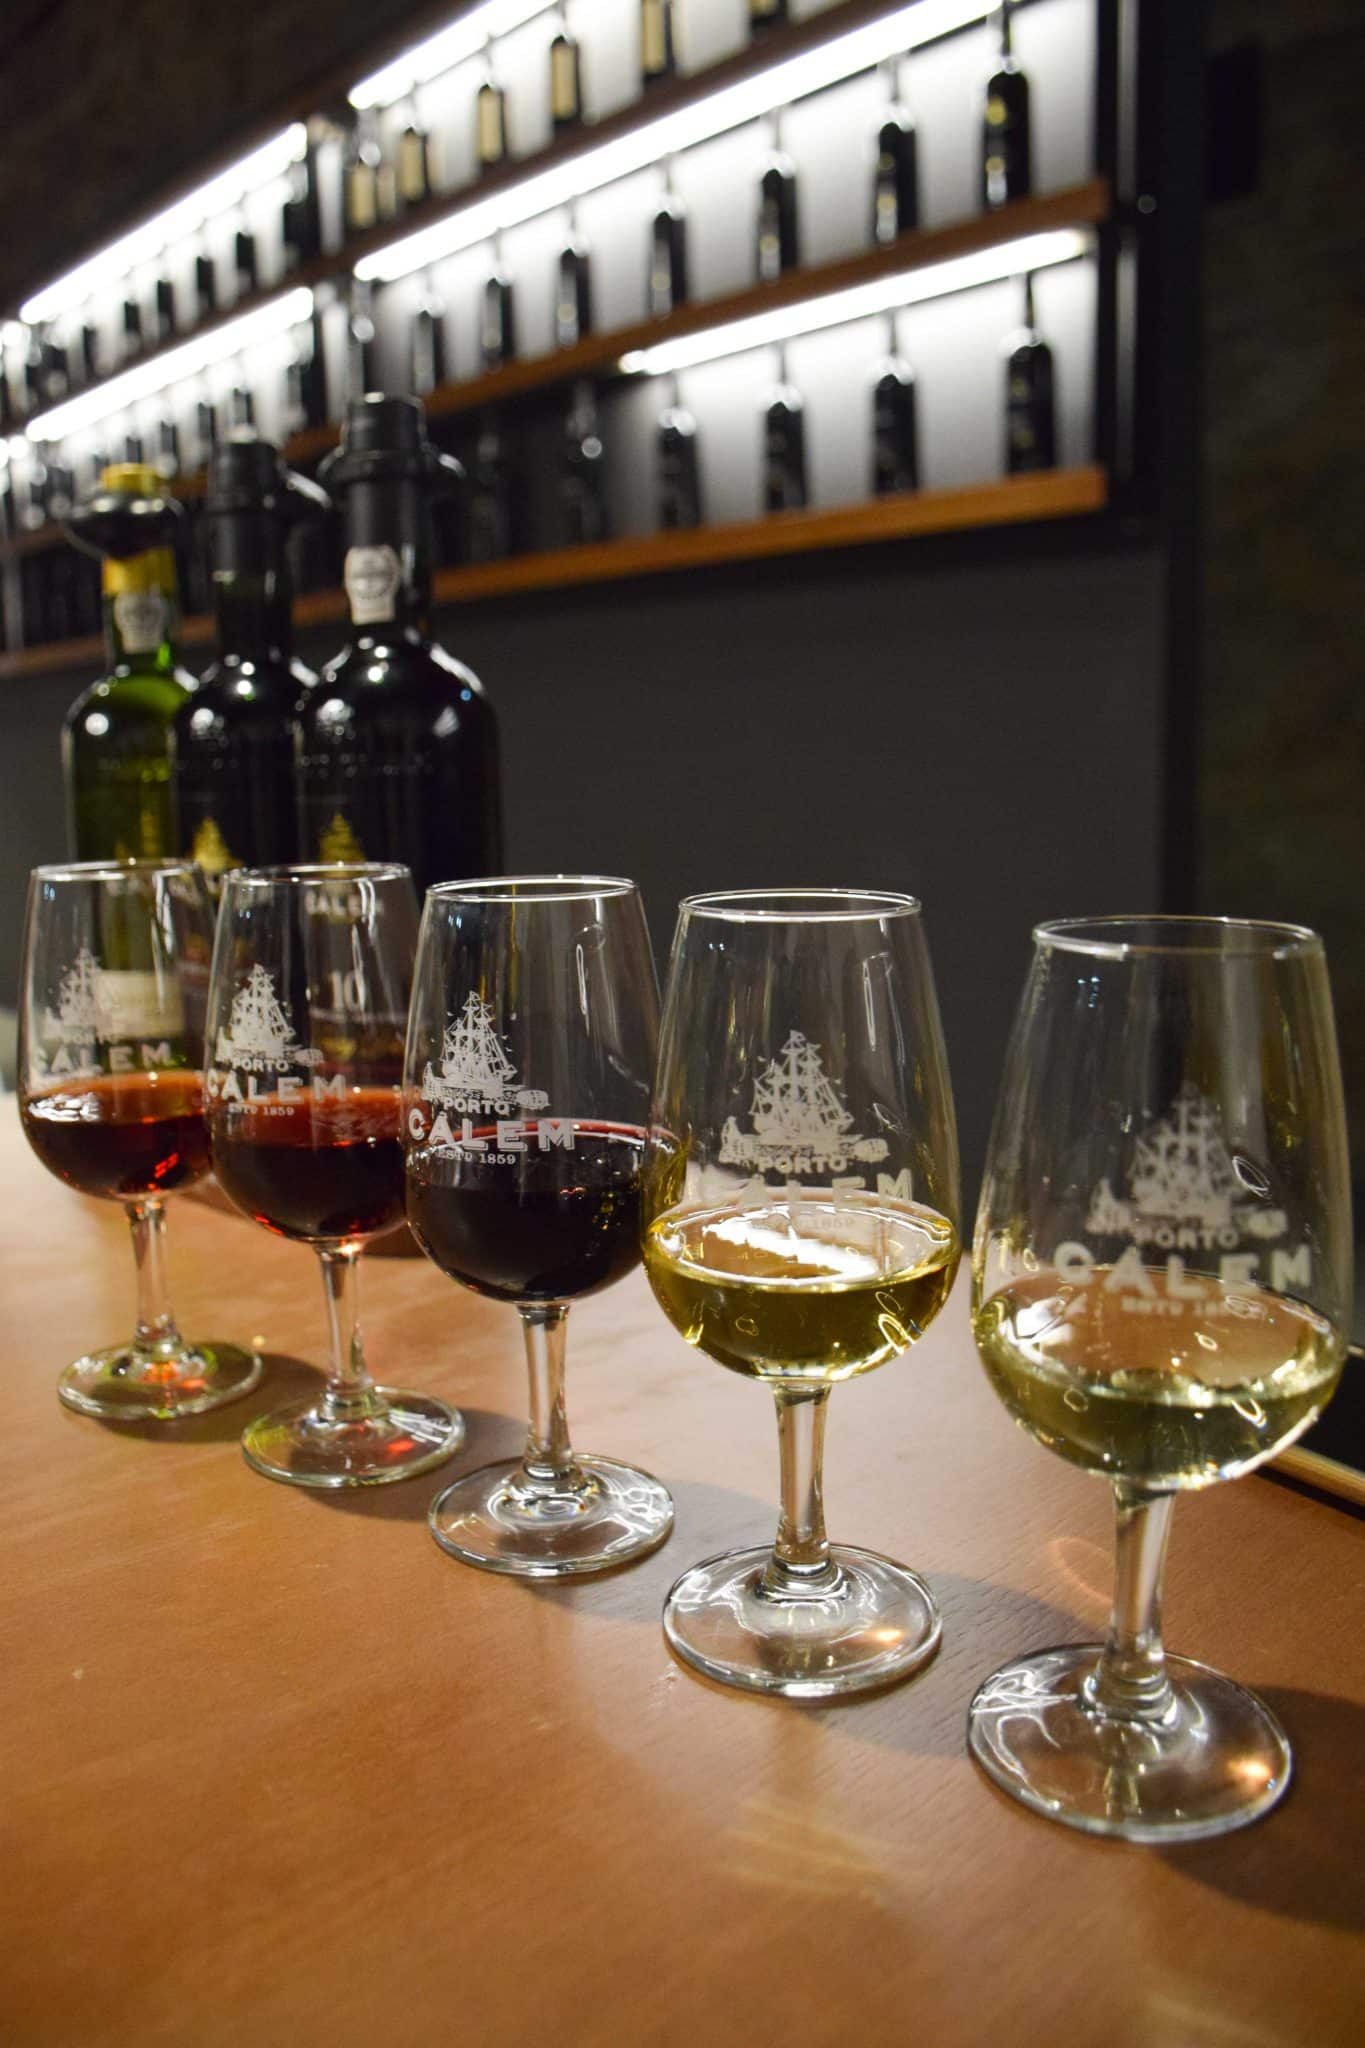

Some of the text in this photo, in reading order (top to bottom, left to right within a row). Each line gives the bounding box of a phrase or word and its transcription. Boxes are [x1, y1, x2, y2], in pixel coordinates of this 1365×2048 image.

[232, 1058, 289, 1073] PORTO
[263, 1106, 295, 1116] 1859
[443, 1097, 511, 1117] PORTO
[409, 1108, 576, 1152] CALEM
[479, 1153, 517, 1165] 1859
[758, 1155, 848, 1175] PORTO
[736, 1168, 914, 1212] ALEM
[1134, 1227, 1240, 1249] PORTO
[1053, 1241, 1312, 1300] CALEM
